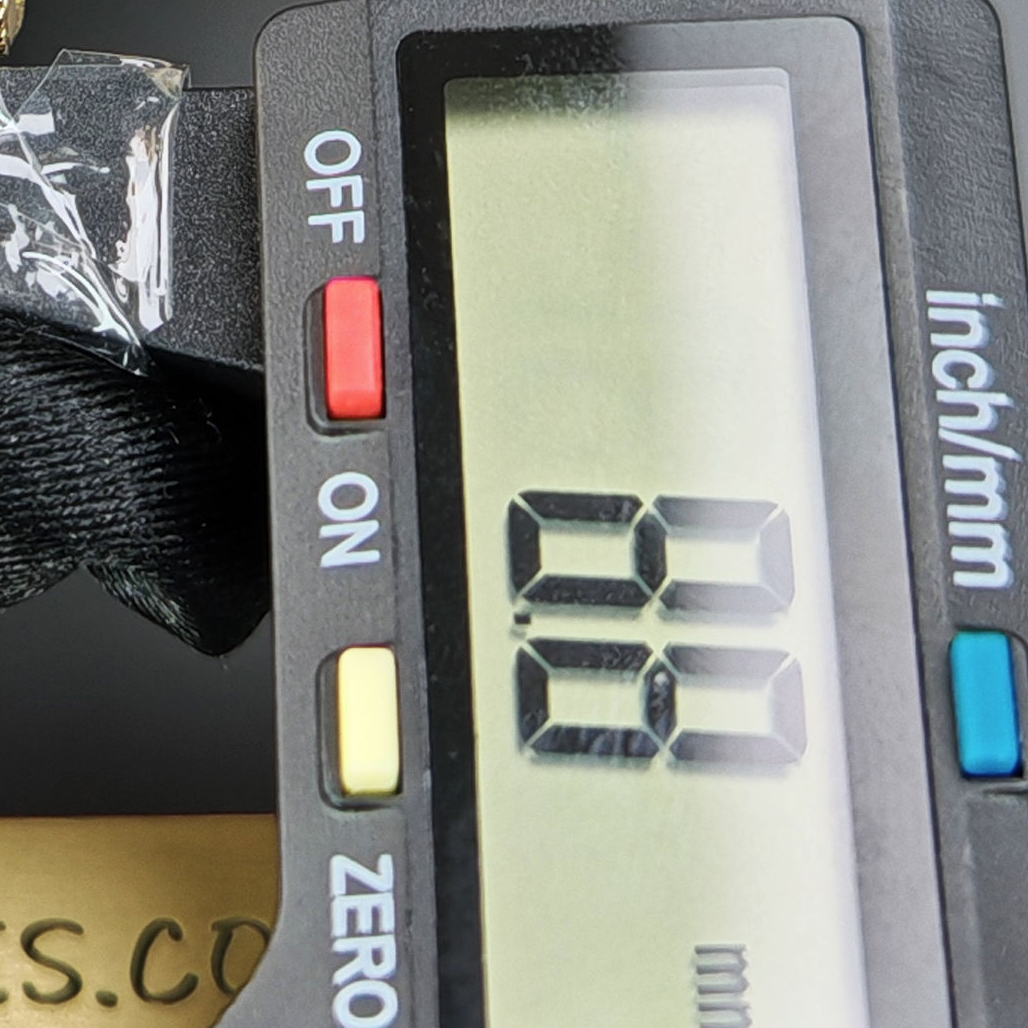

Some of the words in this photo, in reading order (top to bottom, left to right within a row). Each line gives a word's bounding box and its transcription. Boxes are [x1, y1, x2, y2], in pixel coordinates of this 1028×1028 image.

[304, 130, 366, 245] OFF
[926, 290, 1021, 590] inch/mm
[318, 472, 381, 568] ON
[329, 853, 399, 1028] ZERO
